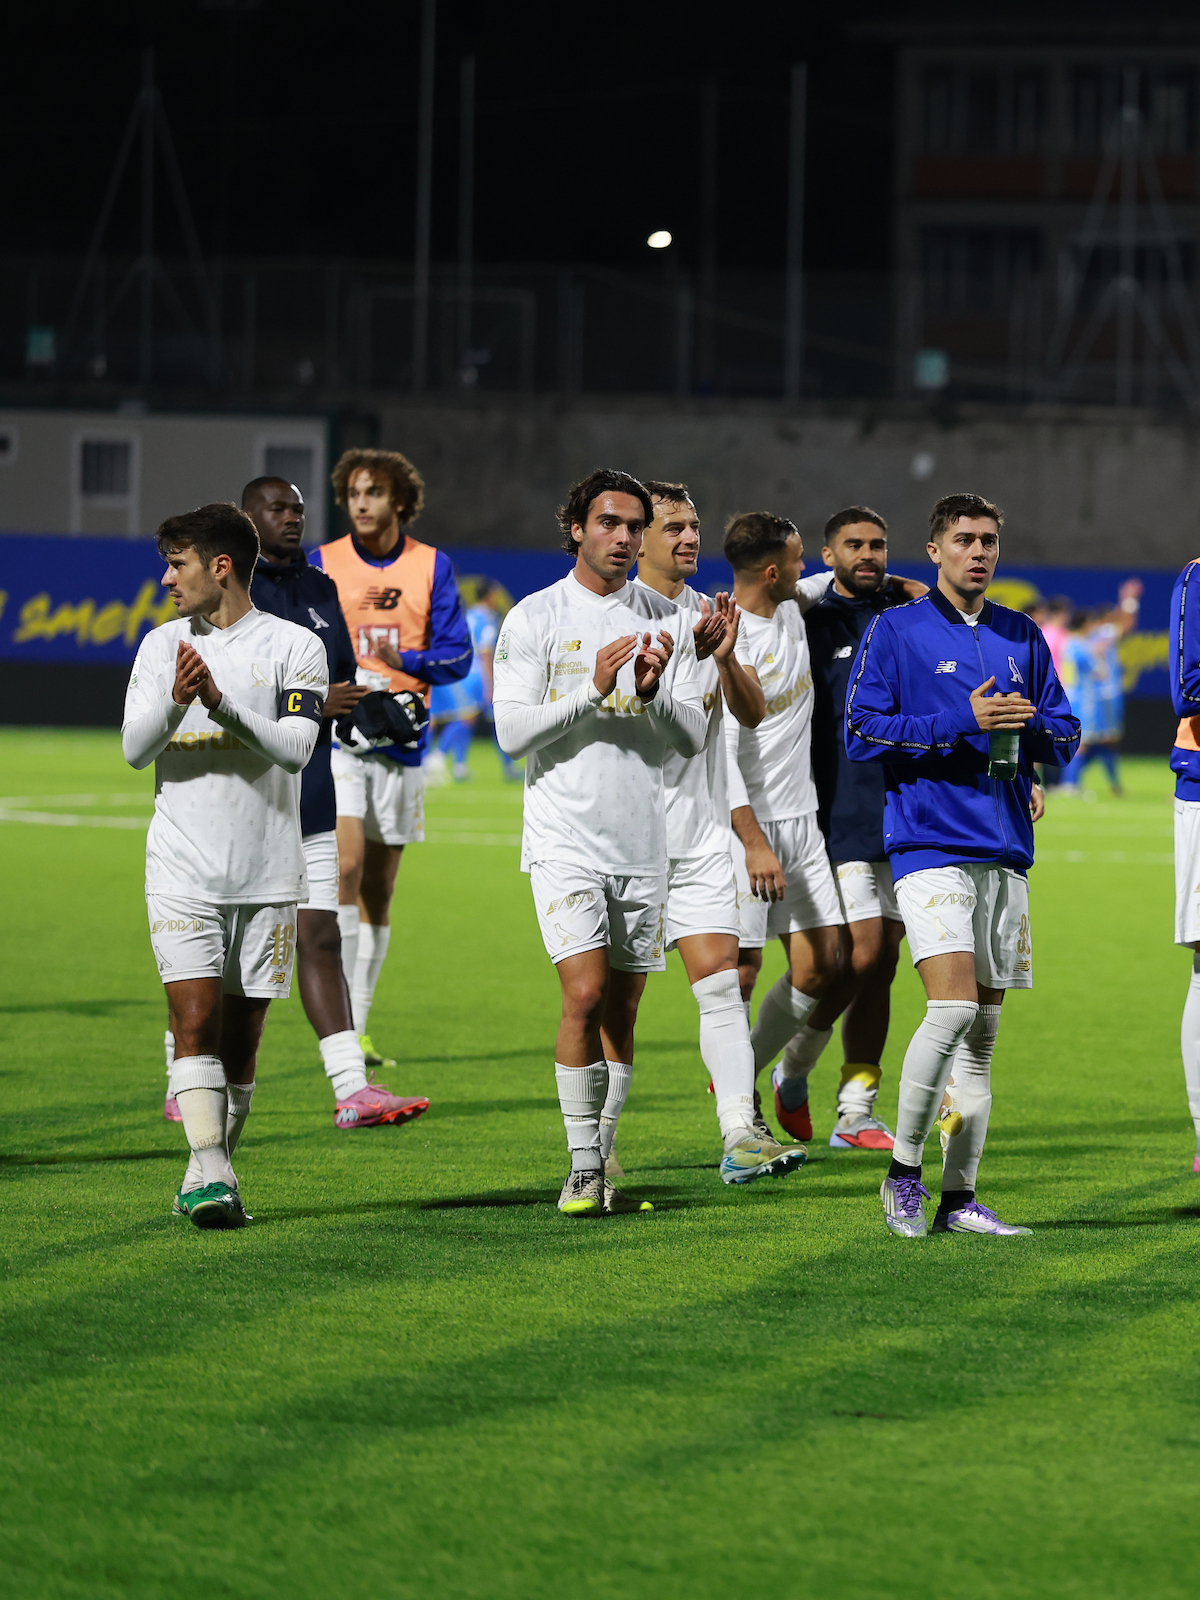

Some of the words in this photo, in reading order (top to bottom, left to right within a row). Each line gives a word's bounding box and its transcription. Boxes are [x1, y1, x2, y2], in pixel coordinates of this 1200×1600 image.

[554, 667, 590, 677] REVERBERI
[555, 661, 582, 669] ANNOVI
[288, 692, 302, 712] C
[271, 924, 294, 966] 16
[196, 1134, 217, 1149] 1912
